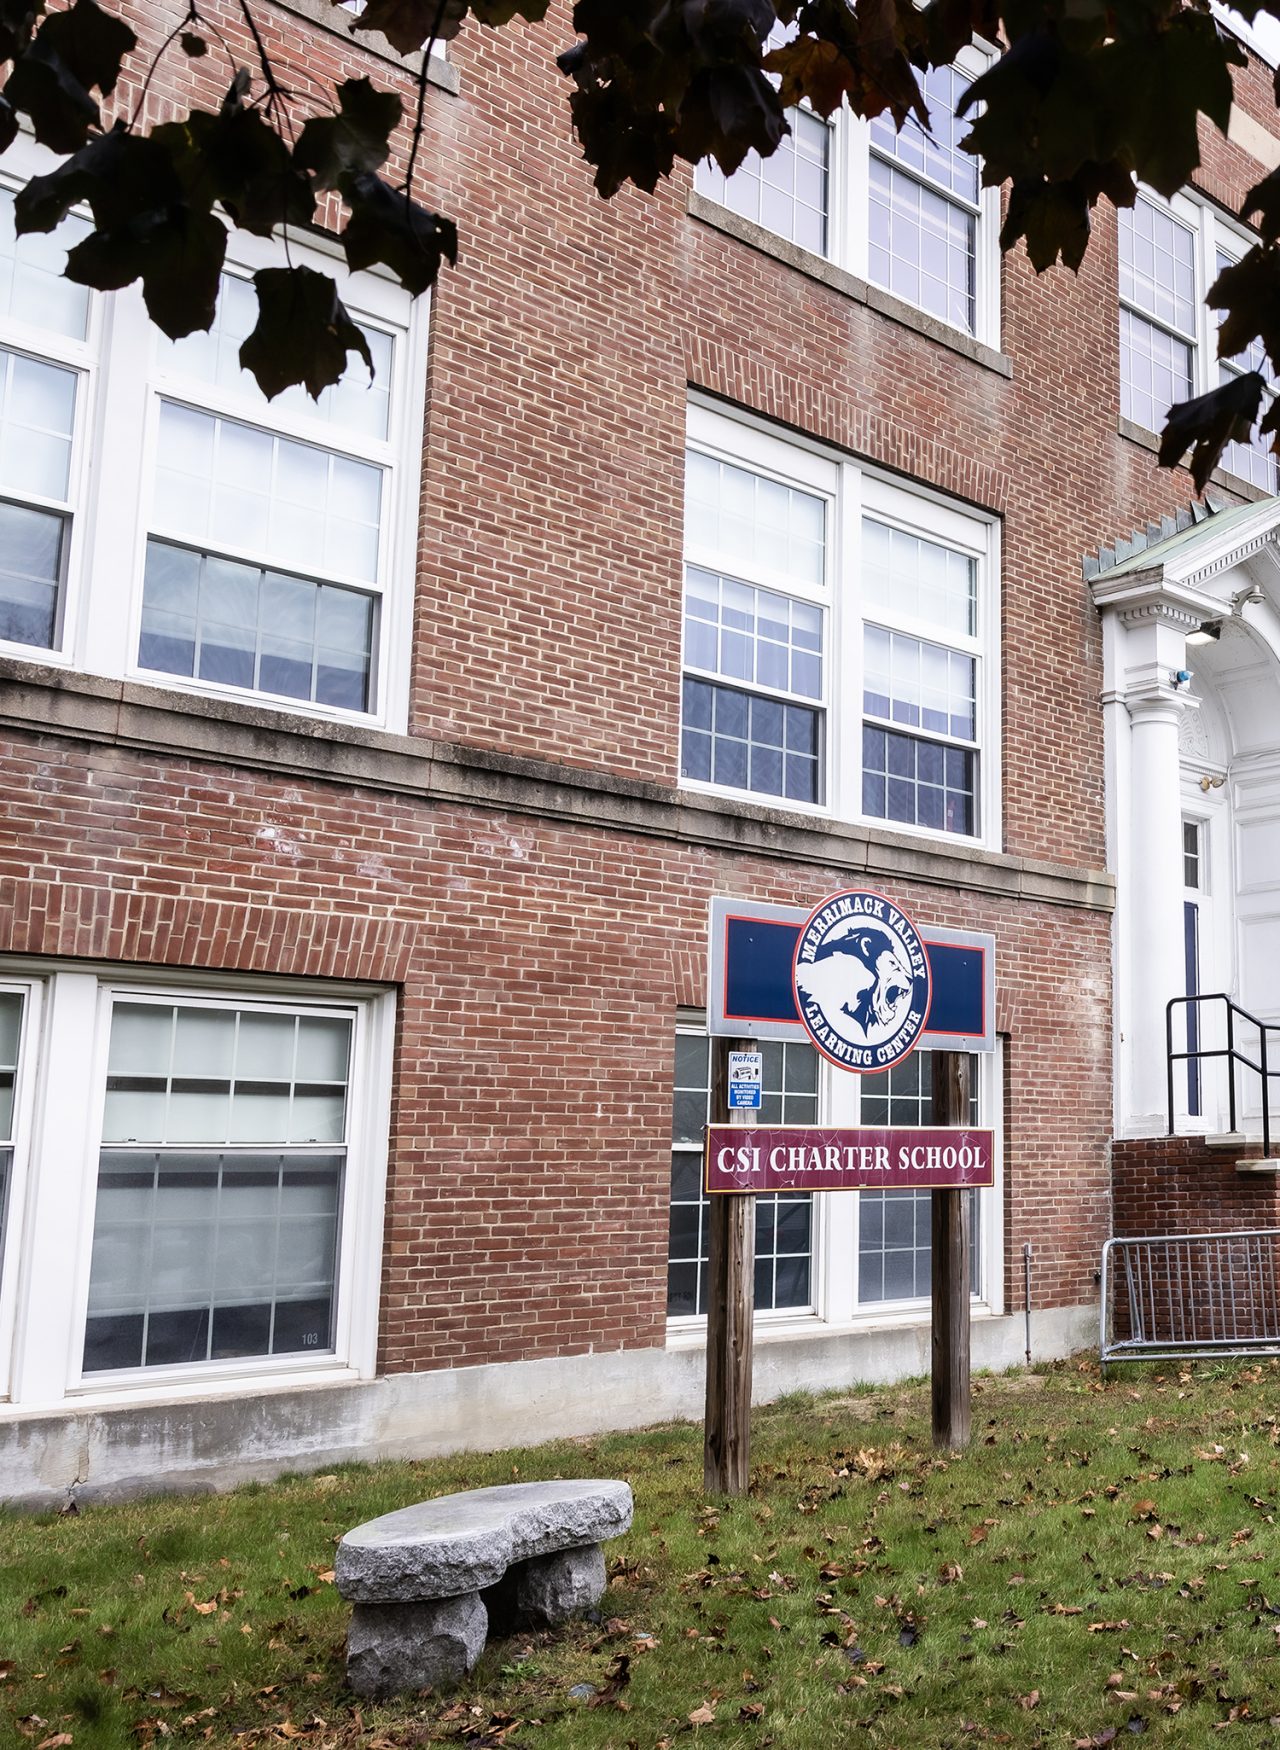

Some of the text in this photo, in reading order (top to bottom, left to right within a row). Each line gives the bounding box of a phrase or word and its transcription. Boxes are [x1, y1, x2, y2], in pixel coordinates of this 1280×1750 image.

[801, 896, 927, 980] MERRIMACK VALLEY
[805, 1004, 922, 1066] LEARNING CENTER
[717, 1145, 986, 1173] CSI CHARTER SCHOOL
[302, 1332, 318, 1345] 103
